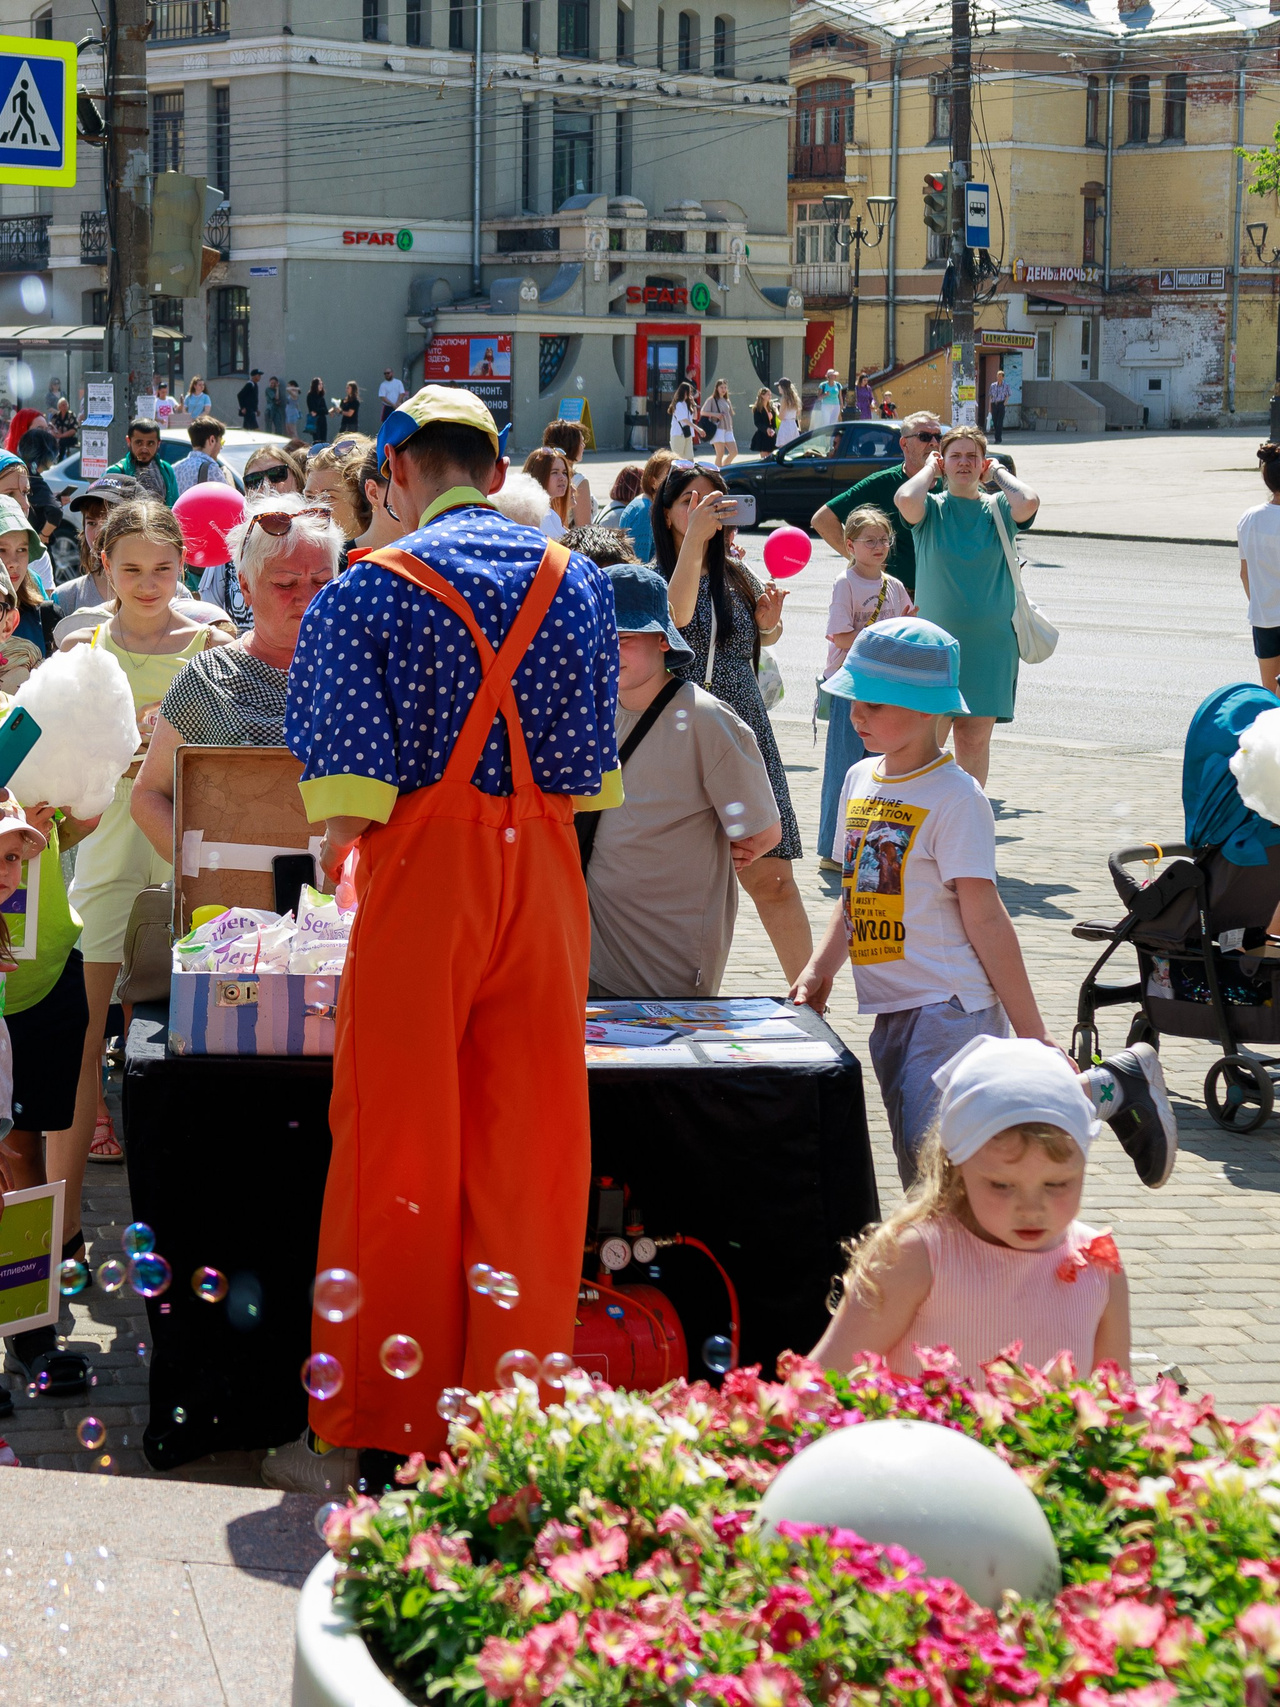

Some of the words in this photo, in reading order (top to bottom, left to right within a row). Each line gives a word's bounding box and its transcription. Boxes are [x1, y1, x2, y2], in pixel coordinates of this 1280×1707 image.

[342, 230, 395, 246] SPAR
[1026, 267, 1054, 283] ДЕНЬ
[1060, 267, 1086, 282] НОЧЬ
[1086, 267, 1099, 282] 24
[626, 286, 689, 305] SPAR
[427, 347, 442, 355] МТС
[427, 355, 451, 363] ЗДЕСЬ
[863, 795, 904, 809] FUTURE
[850, 804, 913, 822] GENERATION
[875, 909, 887, 917] THE
